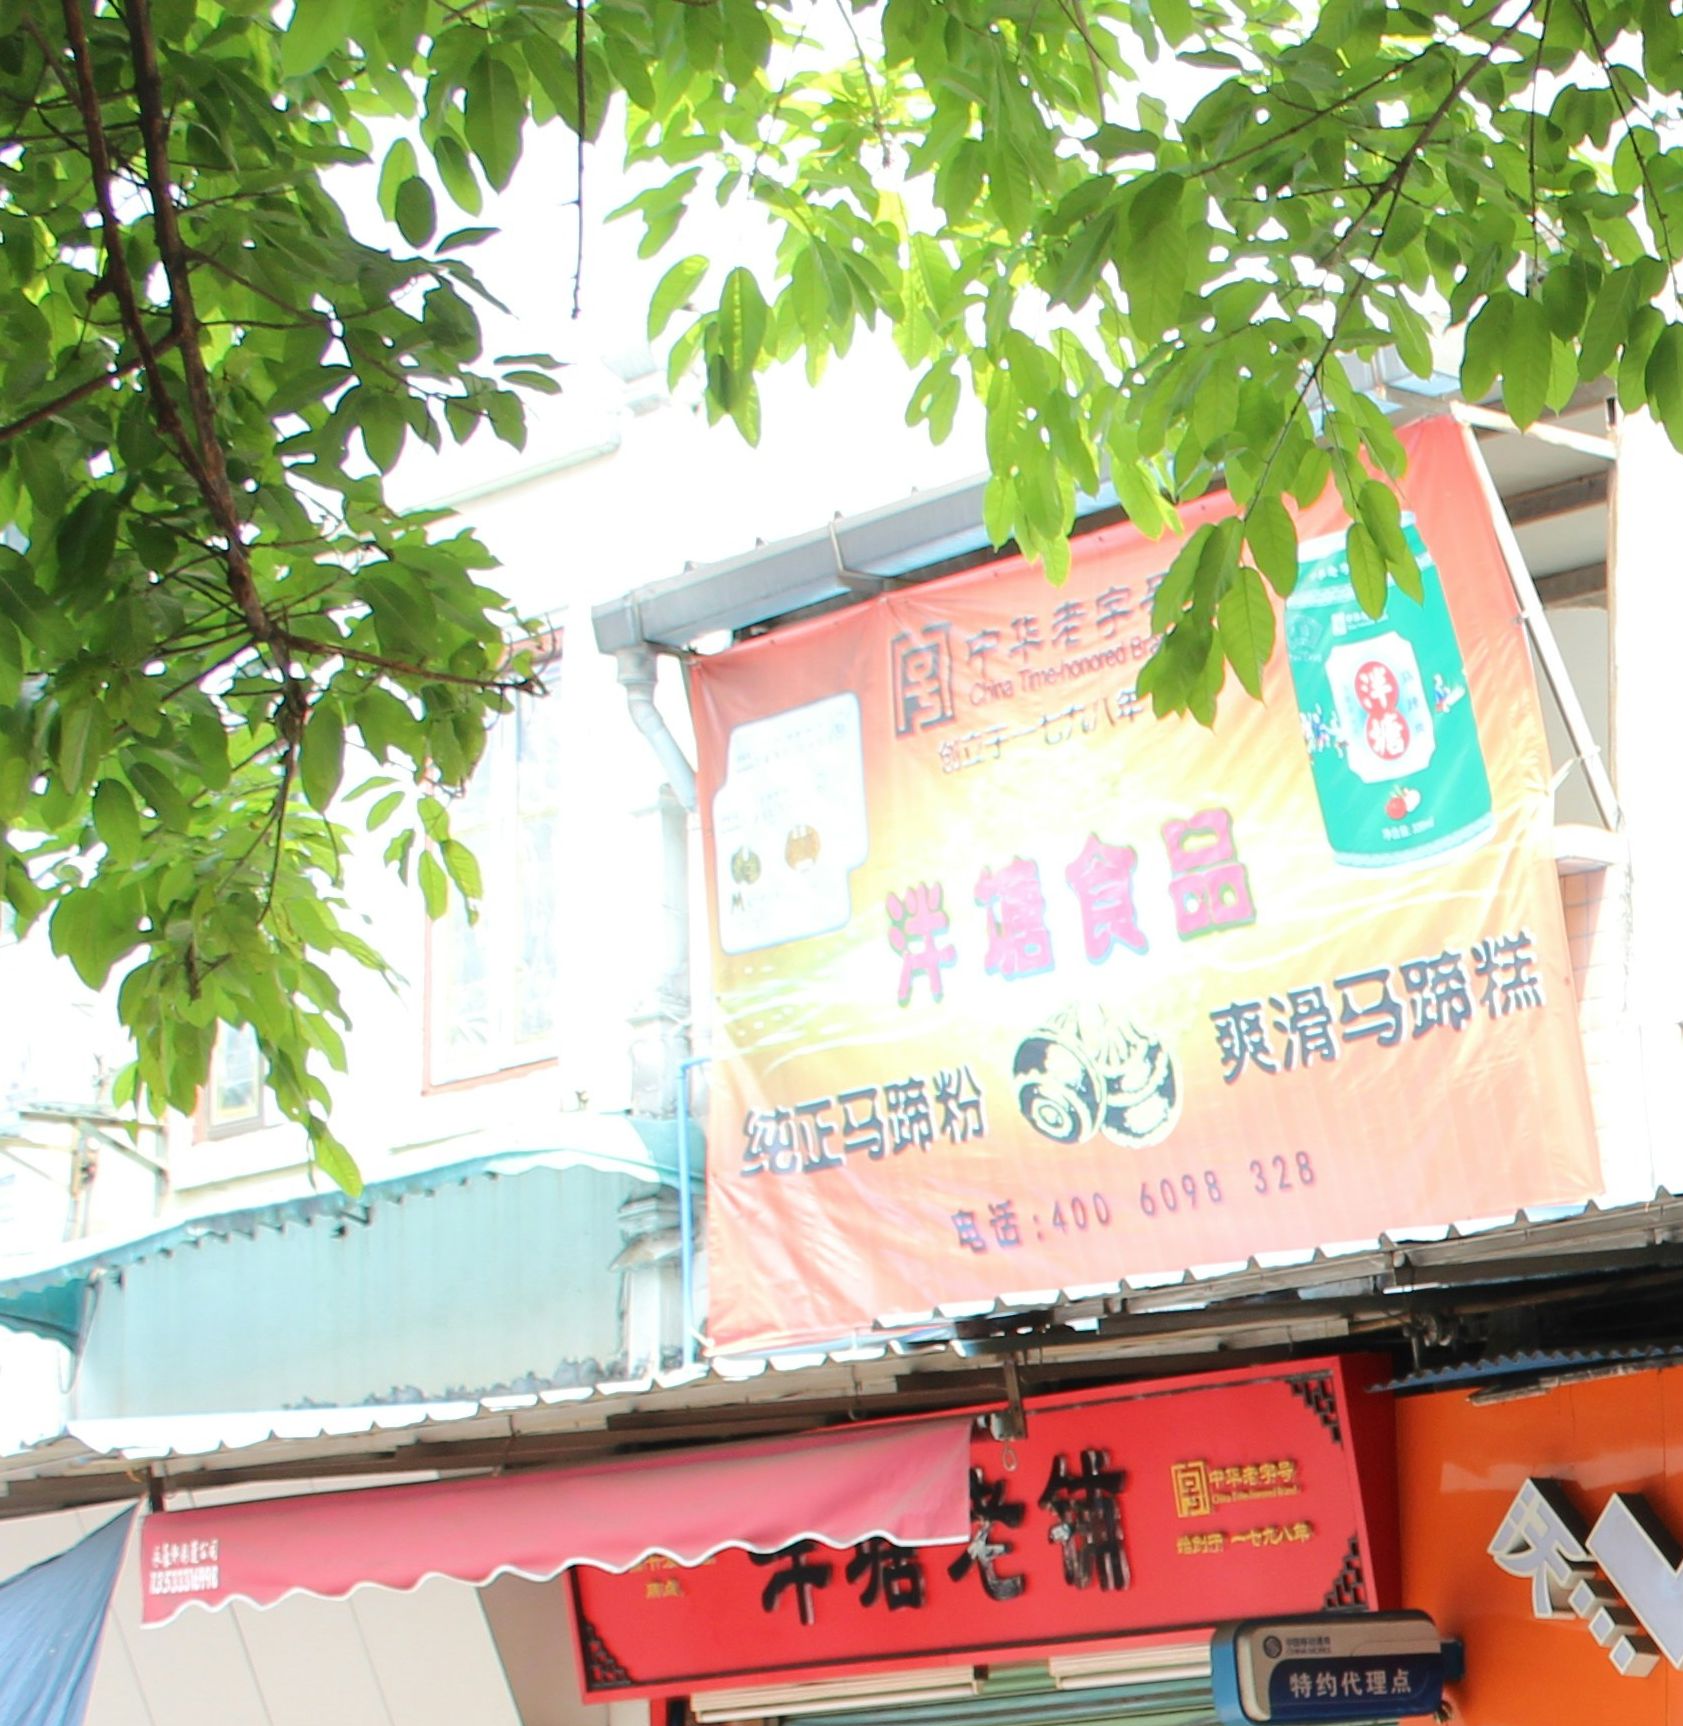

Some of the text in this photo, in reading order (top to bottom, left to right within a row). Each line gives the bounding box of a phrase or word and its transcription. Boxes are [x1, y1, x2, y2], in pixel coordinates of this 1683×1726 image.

[1129, 633, 1163, 662] Bra
[1209, 927, 1545, 1086] 爽滑马蹄糕
[740, 1066, 988, 1179] 纯正马蹄粉
[1139, 1169, 1224, 1218] 6098
[1252, 1149, 1316, 1196] 328
[1288, 1669, 1412, 1699] 特约代理点
